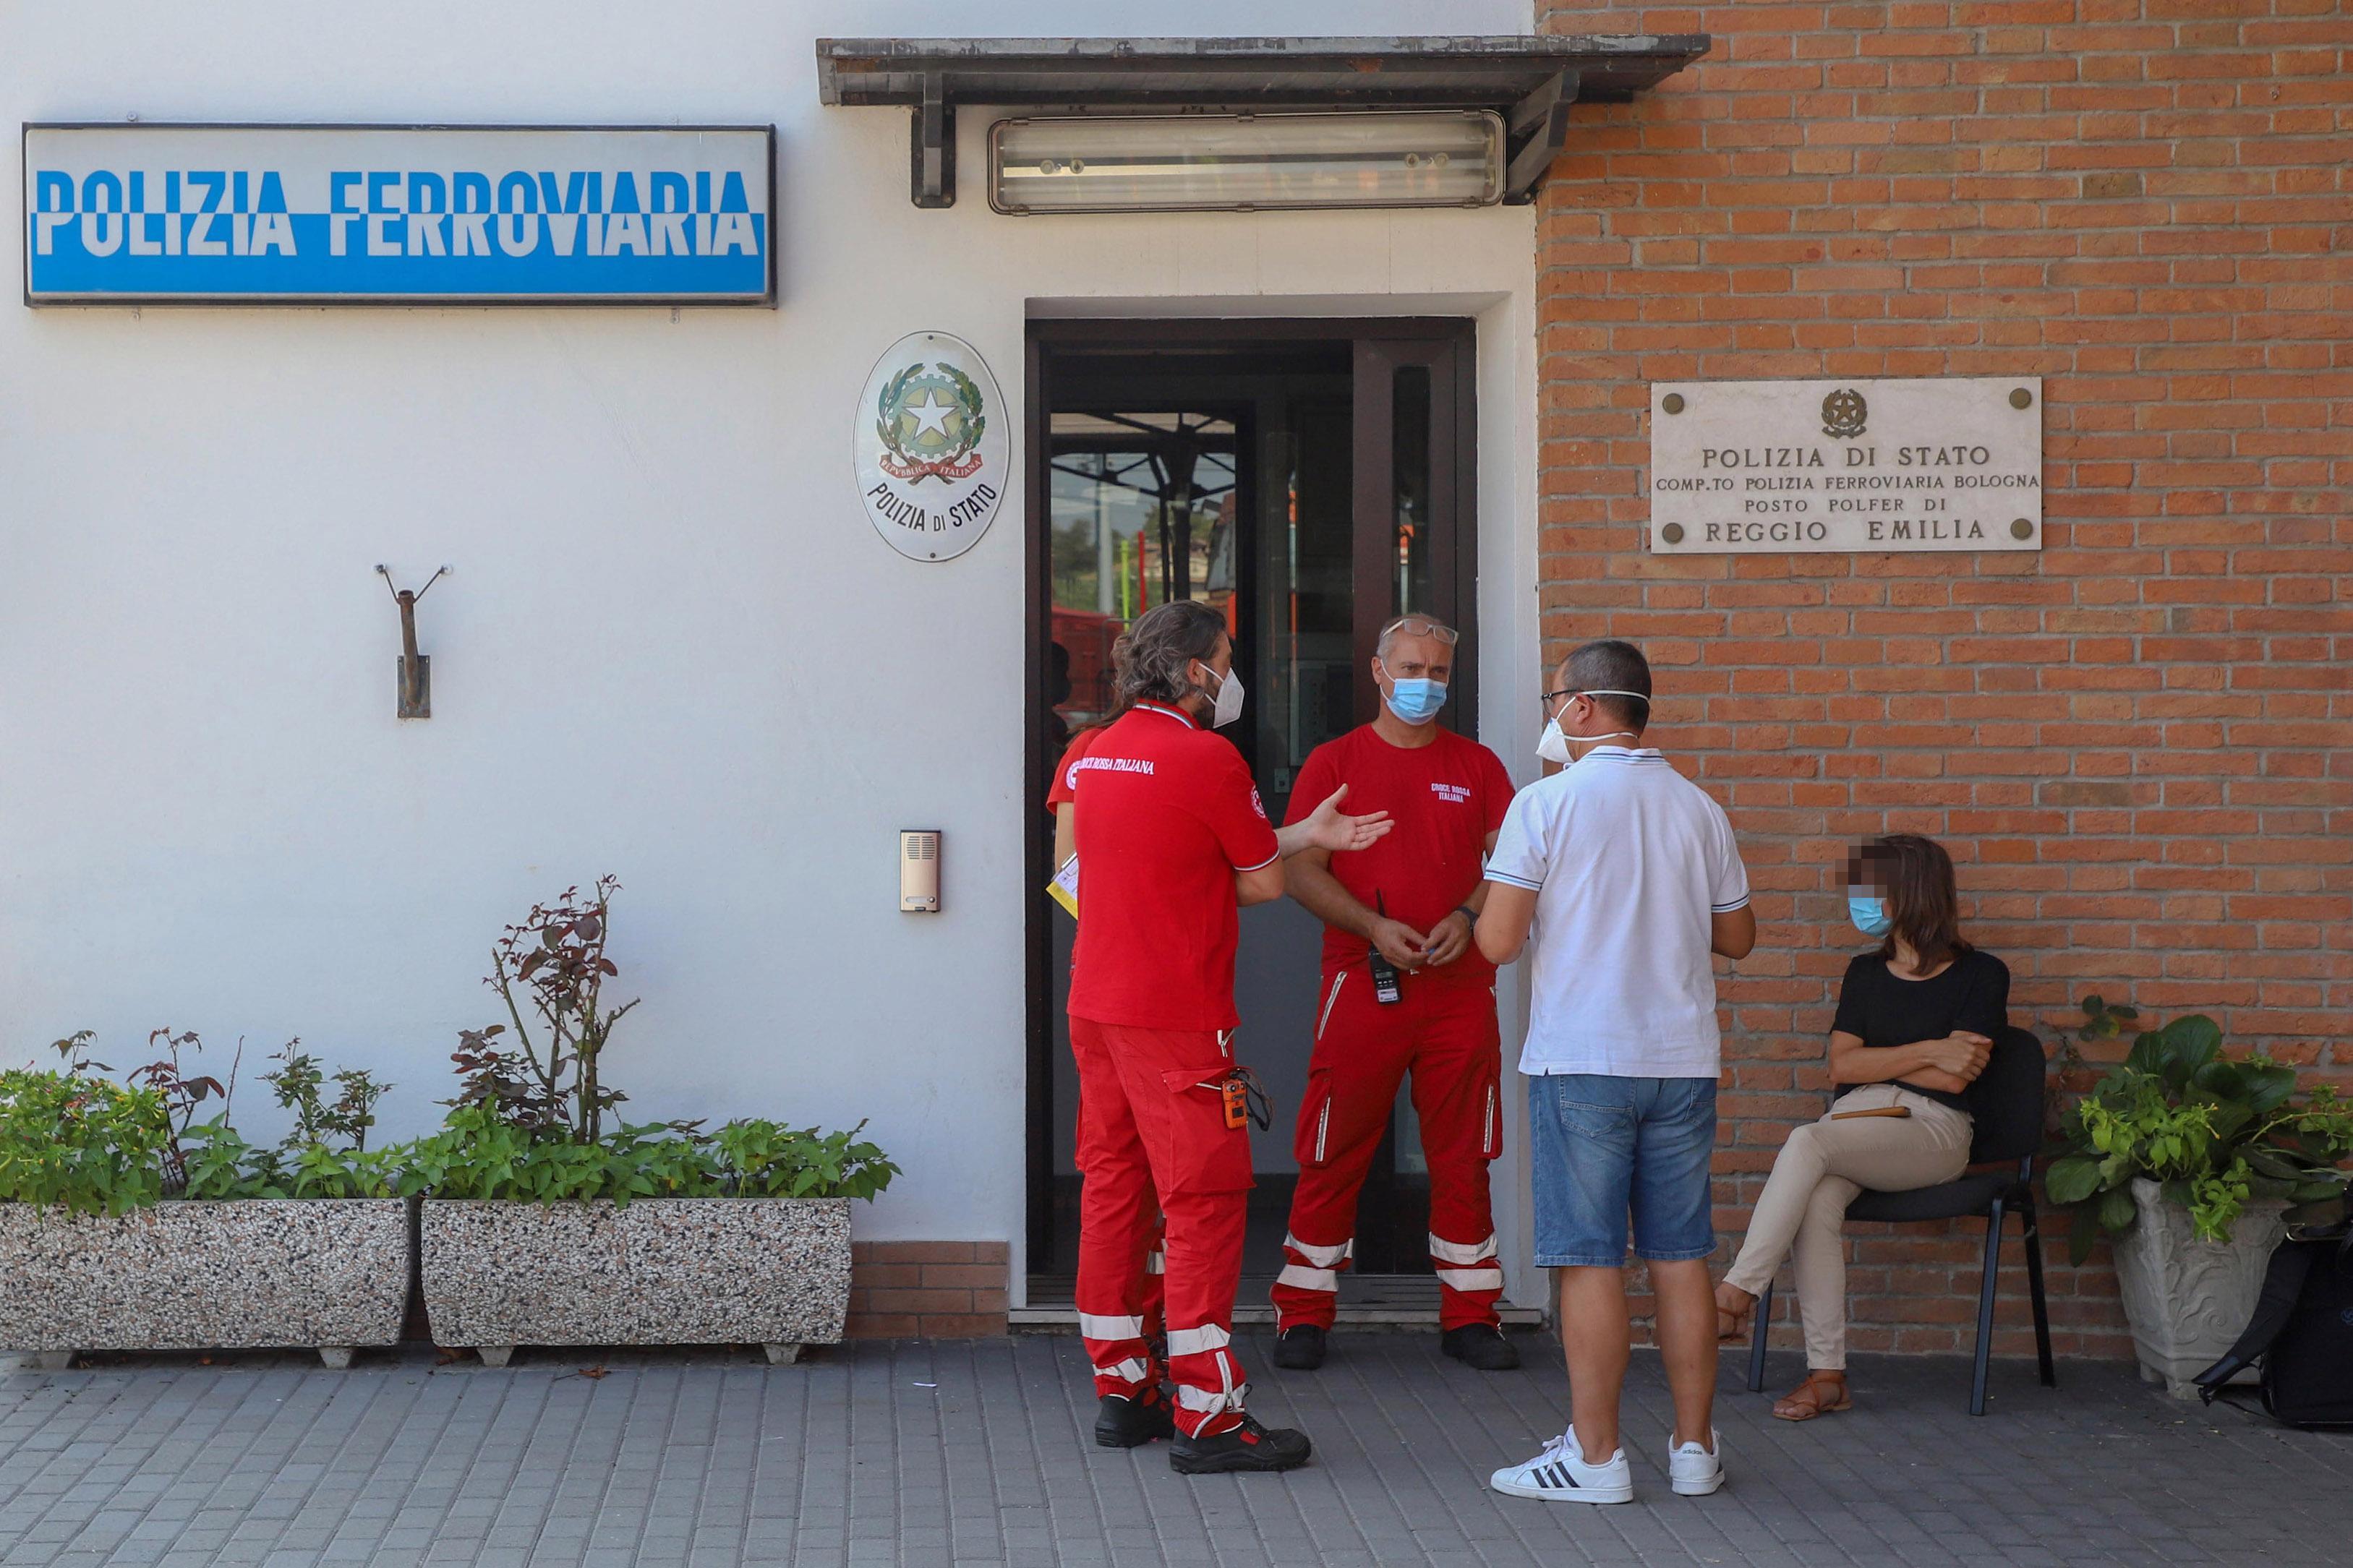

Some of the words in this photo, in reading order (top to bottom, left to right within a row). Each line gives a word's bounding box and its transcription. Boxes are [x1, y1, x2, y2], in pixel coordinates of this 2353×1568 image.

[36, 171, 296, 257] POLIZIA
[329, 171, 759, 257] FERROVIARIA
[1702, 448, 1824, 468] POLIZIA
[1846, 447, 1876, 466] DI
[1898, 446, 1990, 466] STATO
[941, 459, 982, 476] ITALIANA
[1656, 478, 1734, 491] COMP.TO
[1745, 477, 1814, 490] POLIZIA
[1825, 476, 1945, 489] FERROVIARIA
[1954, 474, 2040, 488] BOLOGNA
[867, 482, 925, 531] POLIZIA
[934, 515, 946, 532] DI
[949, 483, 996, 527] STATO
[1745, 500, 1808, 513] POSTO
[1829, 499, 1904, 512] POLFER
[1924, 498, 1946, 511] DI
[1706, 521, 1827, 541] REGGIO
[1868, 519, 1985, 540] EMILIA
[1094, 758, 1114, 770] ROSSA
[1114, 758, 1154, 774] ITALIANA
[1432, 783, 1451, 792] CROCE
[1439, 792, 1464, 802] ITALIANA
